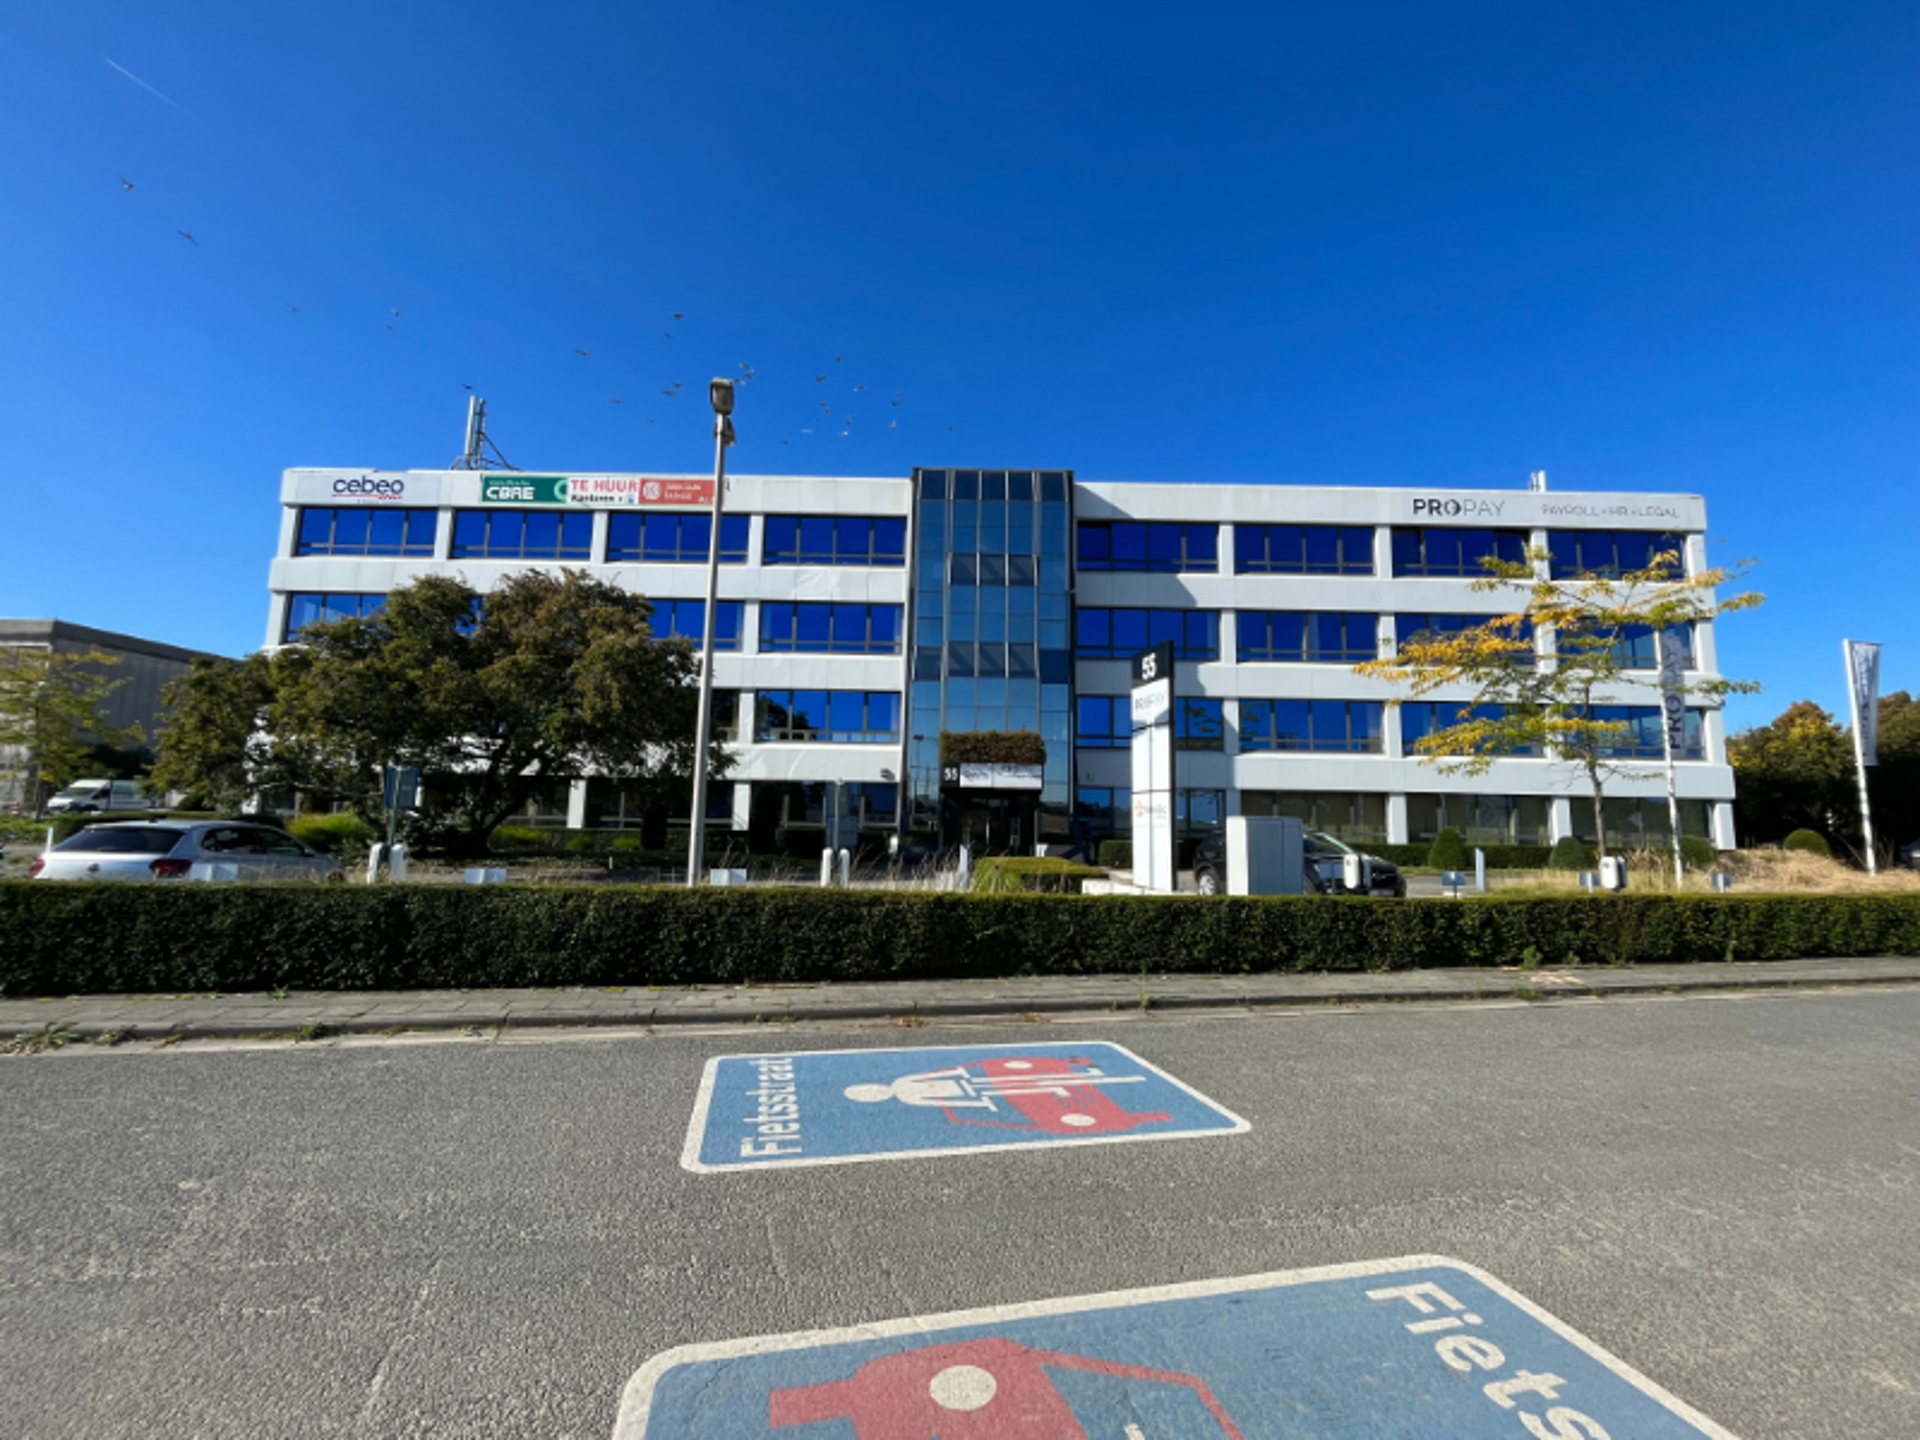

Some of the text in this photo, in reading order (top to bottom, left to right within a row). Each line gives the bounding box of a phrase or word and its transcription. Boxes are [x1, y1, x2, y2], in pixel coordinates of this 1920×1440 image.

[333, 475, 404, 494] cebeo
[571, 479, 637, 492] TE HUUR
[486, 486, 535, 500] CBRE
[1413, 499, 1505, 517] PROPAY
[1542, 503, 1599, 516] PAYROLL
[1639, 506, 1679, 518] LEGAL
[1142, 652, 1157, 680] 55
[944, 767, 959, 781] 55
[740, 1058, 803, 1157] Fietsstraat
